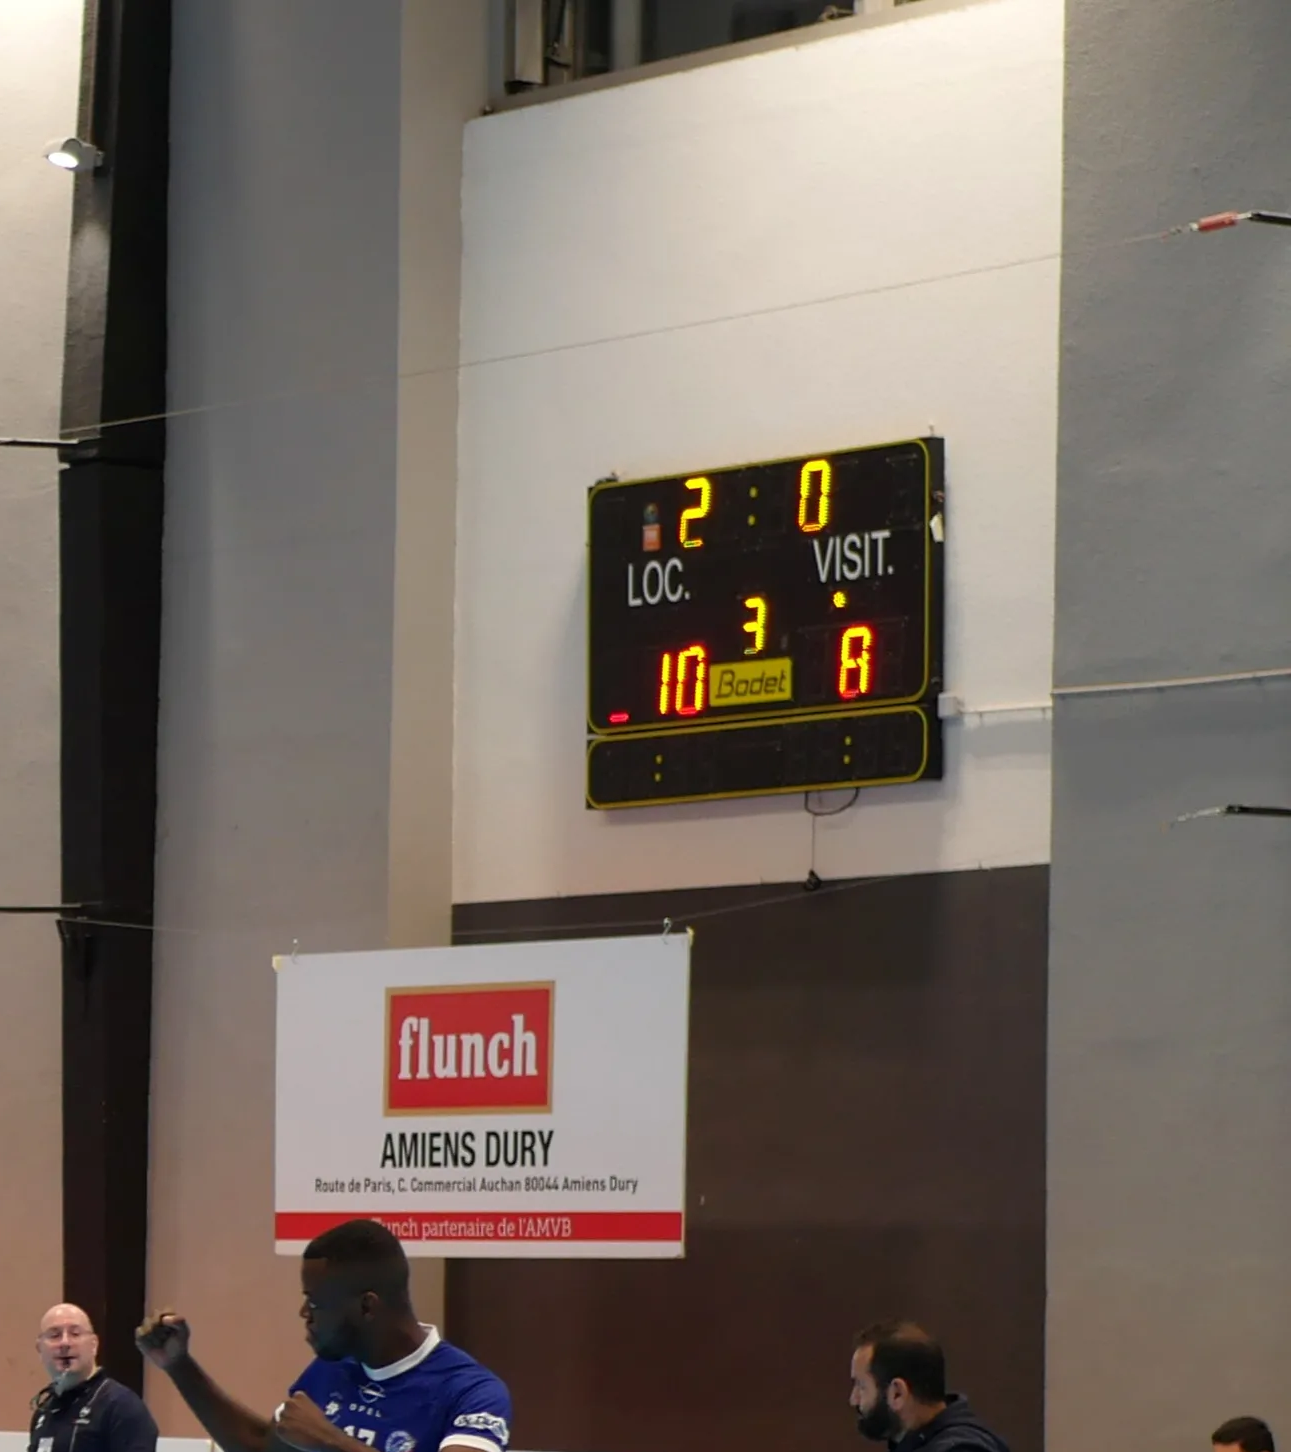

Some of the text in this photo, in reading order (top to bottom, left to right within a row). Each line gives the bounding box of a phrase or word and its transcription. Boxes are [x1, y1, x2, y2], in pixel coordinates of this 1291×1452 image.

[680, 460, 831, 548] 2 0
[813, 530, 894, 584] VISIT.
[627, 558, 690, 607] LOC.
[742, 596, 768, 656] 3
[659, 645, 706, 716] 10
[716, 668, 787, 701] Bodet
[397, 1014, 538, 1081] flunch
[380, 1130, 555, 1168] AMIENS DURY
[315, 1175, 638, 1195] Route de Paris, C. Commercial Auchan 80044 Amiens Dury
[422, 1218, 495, 1241] partenaire
[497, 1217, 515, 1237] de
[519, 1217, 572, 1238] l'AMVB
[349, 1402, 382, 1418] OPEL
